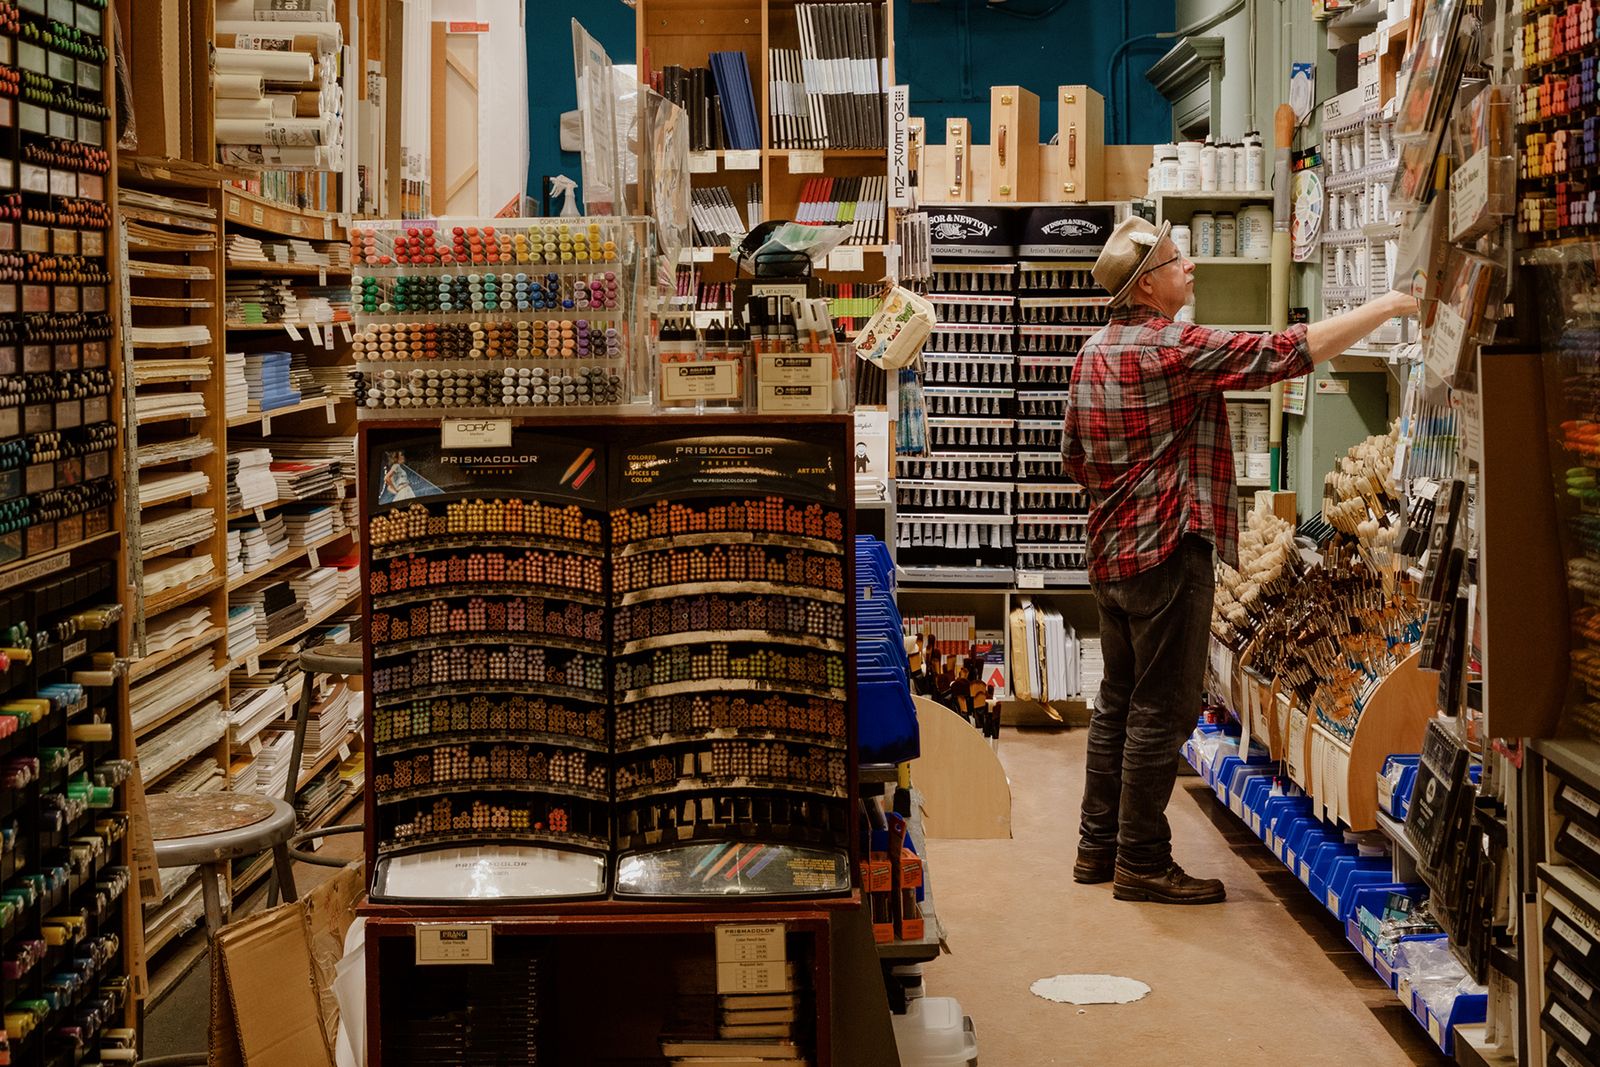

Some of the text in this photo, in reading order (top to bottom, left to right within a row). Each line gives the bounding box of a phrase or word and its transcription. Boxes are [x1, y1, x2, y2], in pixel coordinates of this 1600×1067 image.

[894, 102, 905, 198] MOLESKINE
[560, 217, 586, 225] MARKER
[953, 214, 993, 237] NEWTON
[1040, 219, 1068, 235] WINSOR
[1073, 219, 1100, 235] NEWTON
[675, 446, 774, 455] PRISMACOLOR
[440, 455, 539, 464] PRISMACOLOR
